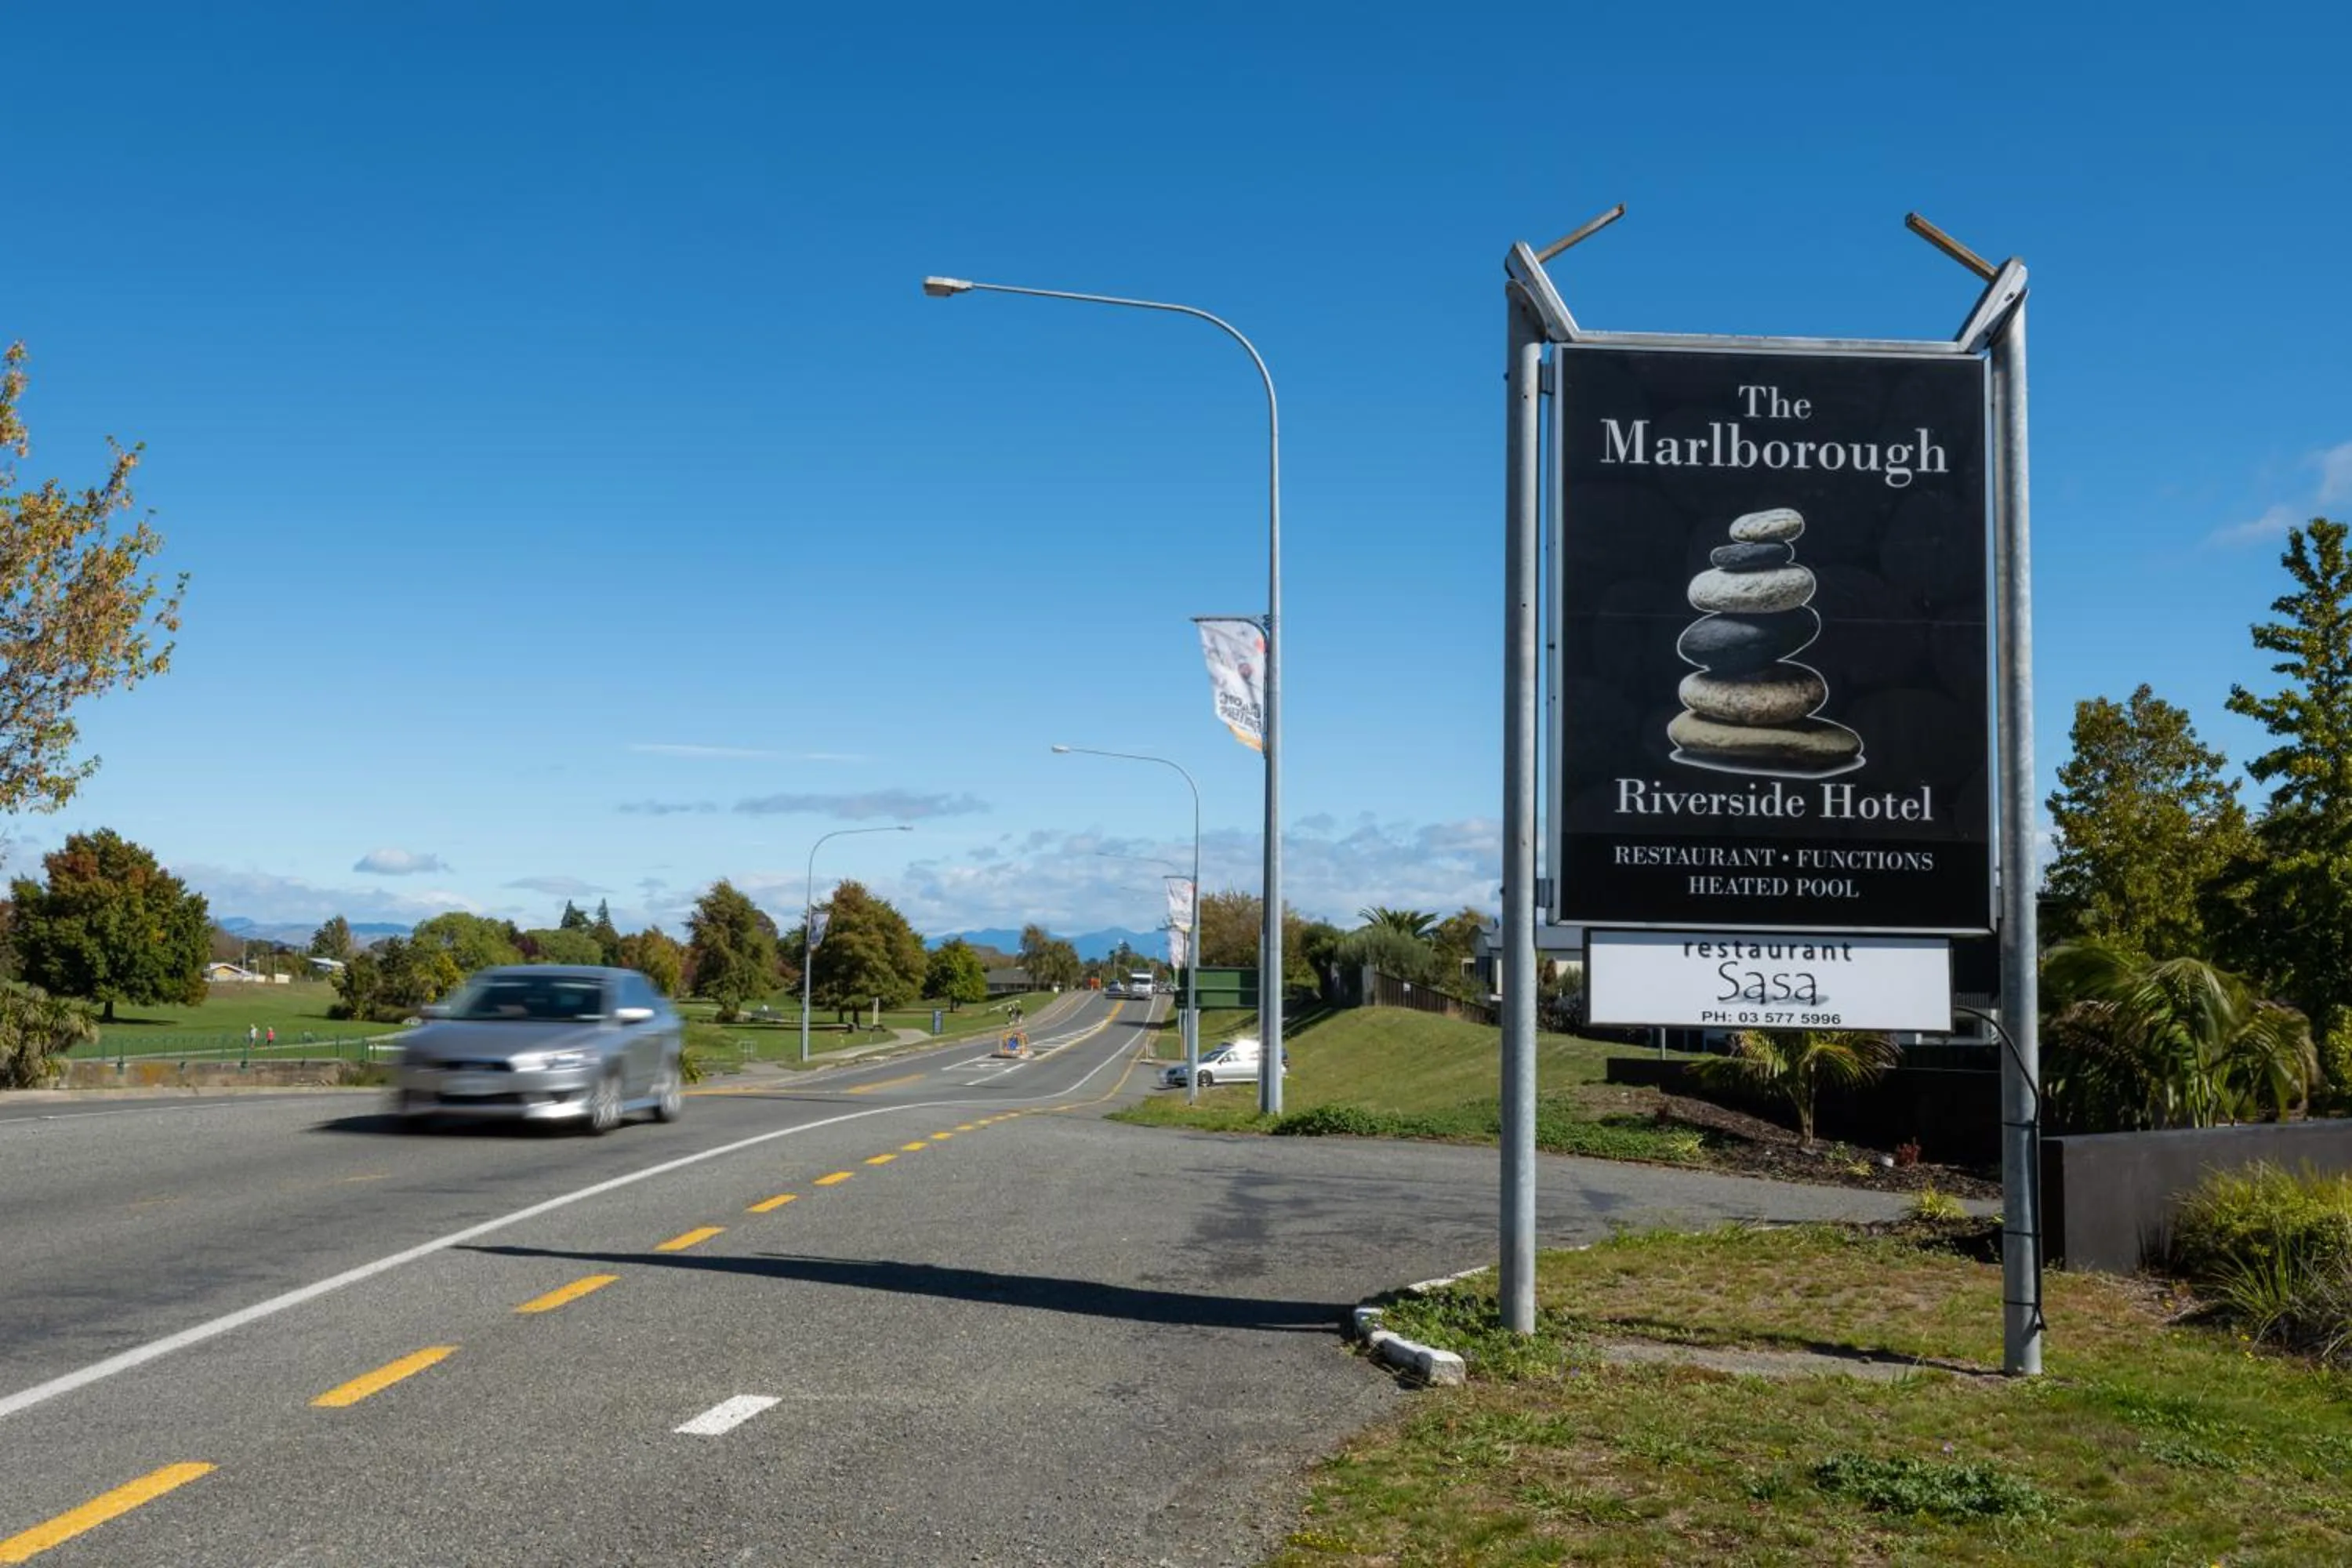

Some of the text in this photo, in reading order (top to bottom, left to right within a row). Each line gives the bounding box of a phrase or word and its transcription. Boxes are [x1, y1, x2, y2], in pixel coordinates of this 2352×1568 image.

[1738, 385, 1812, 419] The
[1600, 418, 1949, 488] Marlborough
[1615, 779, 1933, 821] Riverside Hotel
[1615, 846, 1933, 870] RESTAURANT FUNCTIONS
[1689, 877, 1860, 898] HEATED POOL
[1683, 941, 1853, 962] restaurant
[1717, 960, 1817, 1006] Sasa
[1701, 1011, 1842, 1025] PH: 03 577 5996
